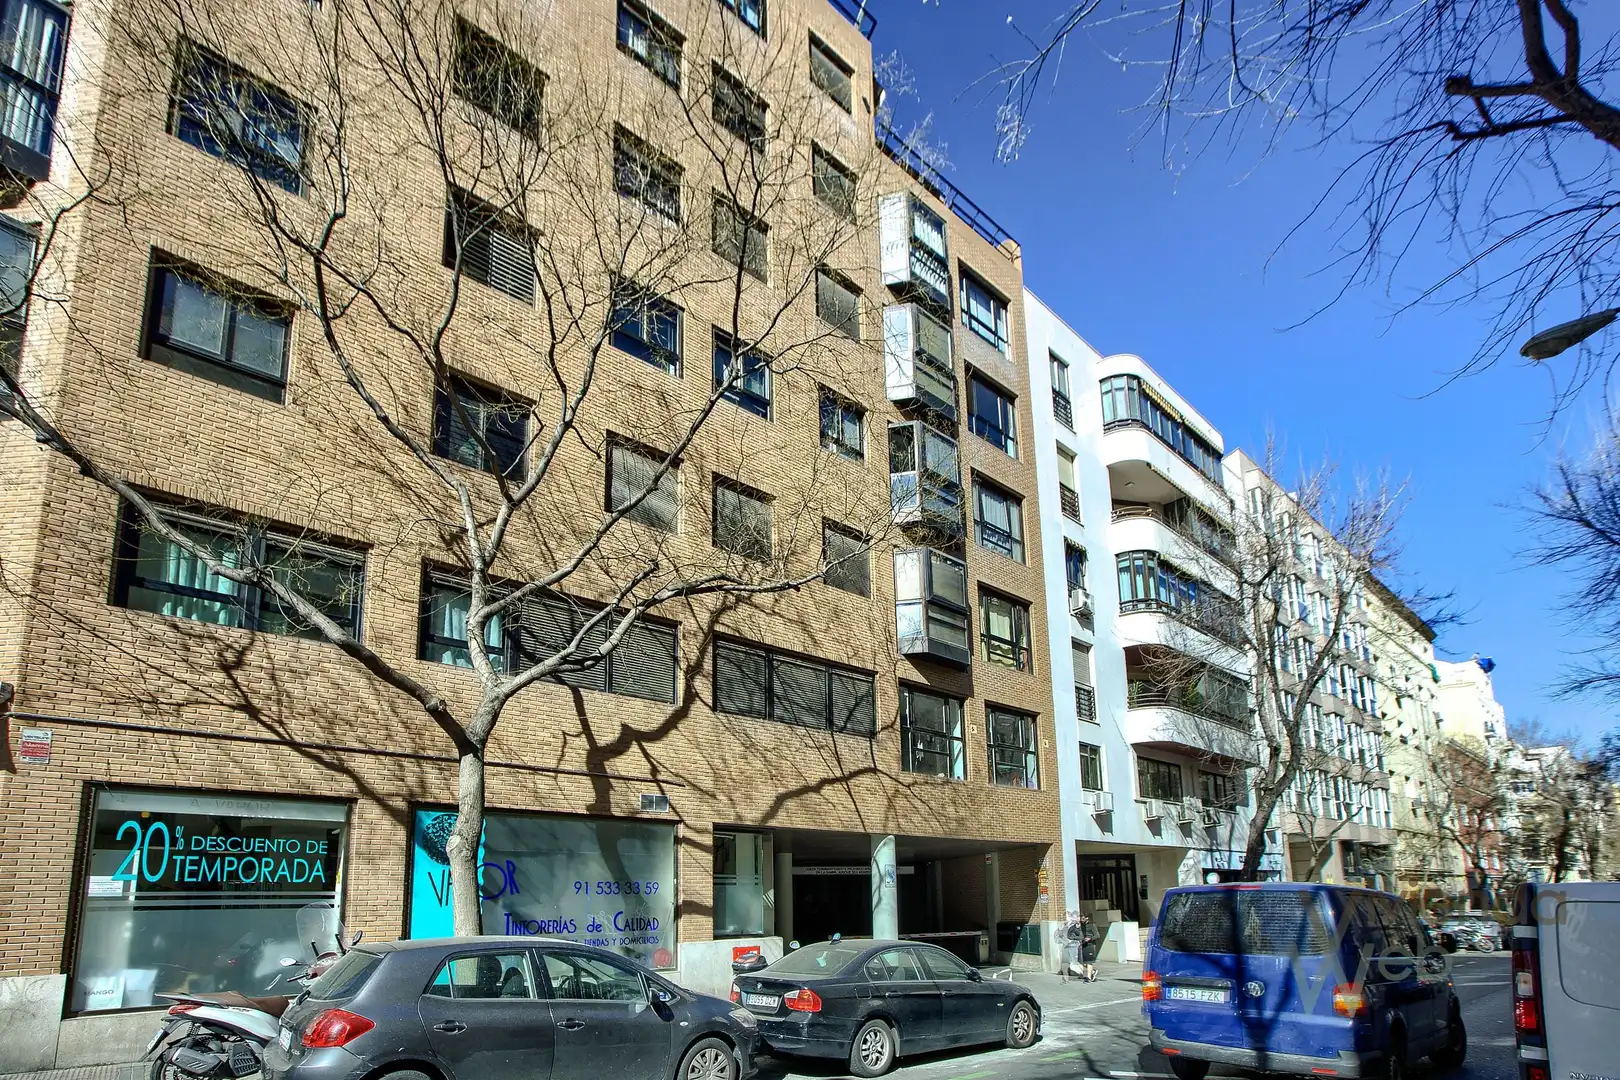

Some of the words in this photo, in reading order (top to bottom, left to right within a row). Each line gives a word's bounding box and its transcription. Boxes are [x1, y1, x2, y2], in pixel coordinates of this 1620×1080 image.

[191, 836, 301, 854] DESCUENTO
[305, 840, 328, 855] DE
[172, 855, 326, 883] TEMPORADA
[574, 881, 588, 895] 91
[595, 881, 621, 895] 533
[624, 881, 640, 895] 33
[644, 881, 660, 896] 59
[586, 916, 602, 933] de
[613, 910, 660, 932] CALIDAD
[612, 937, 617, 946] Y
[619, 936, 660, 946] DOMICILIOS
[1172, 988, 1197, 999] 8515
[1200, 990, 1220, 1002] FZK
